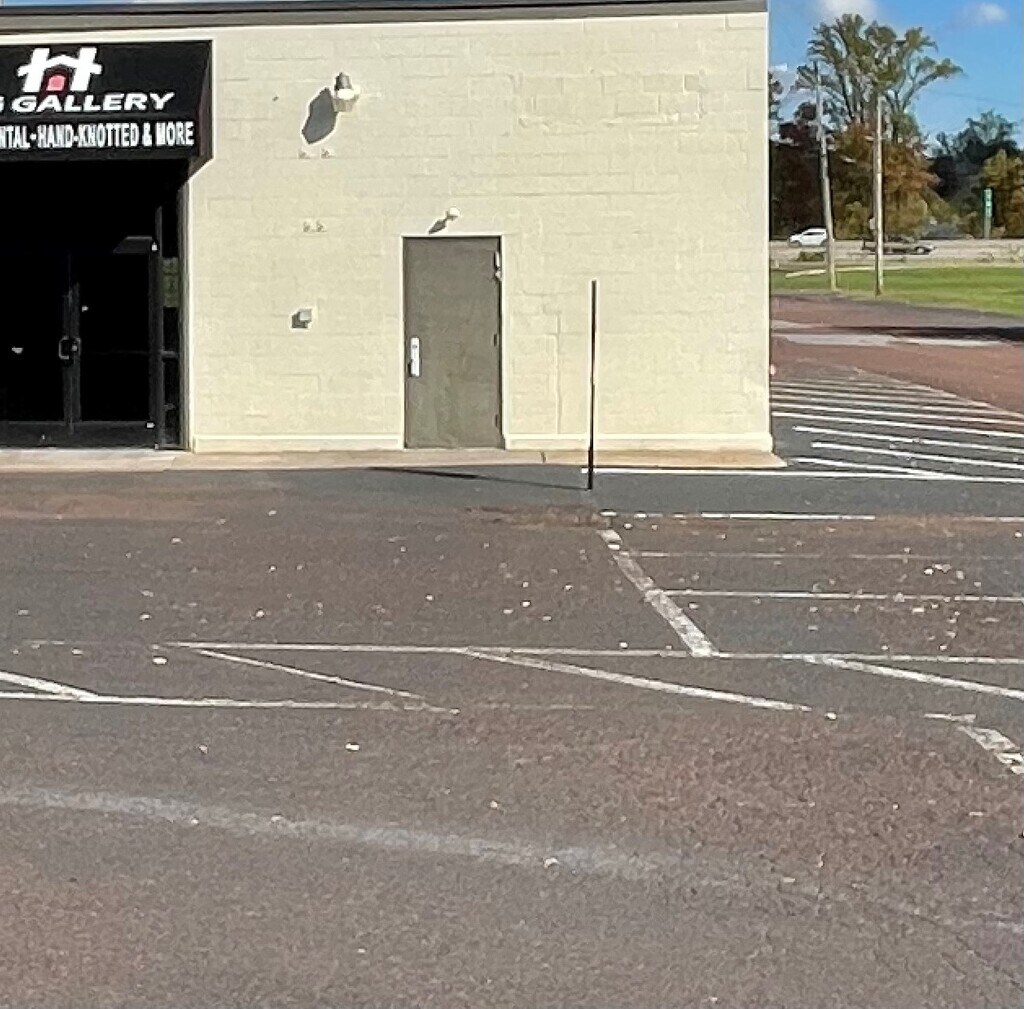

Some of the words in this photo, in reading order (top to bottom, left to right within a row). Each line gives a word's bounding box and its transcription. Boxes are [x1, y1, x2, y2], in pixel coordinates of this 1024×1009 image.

[11, 92, 174, 113] GALLERY
[142, 122, 152, 146] &
[155, 121, 194, 146] MORE
